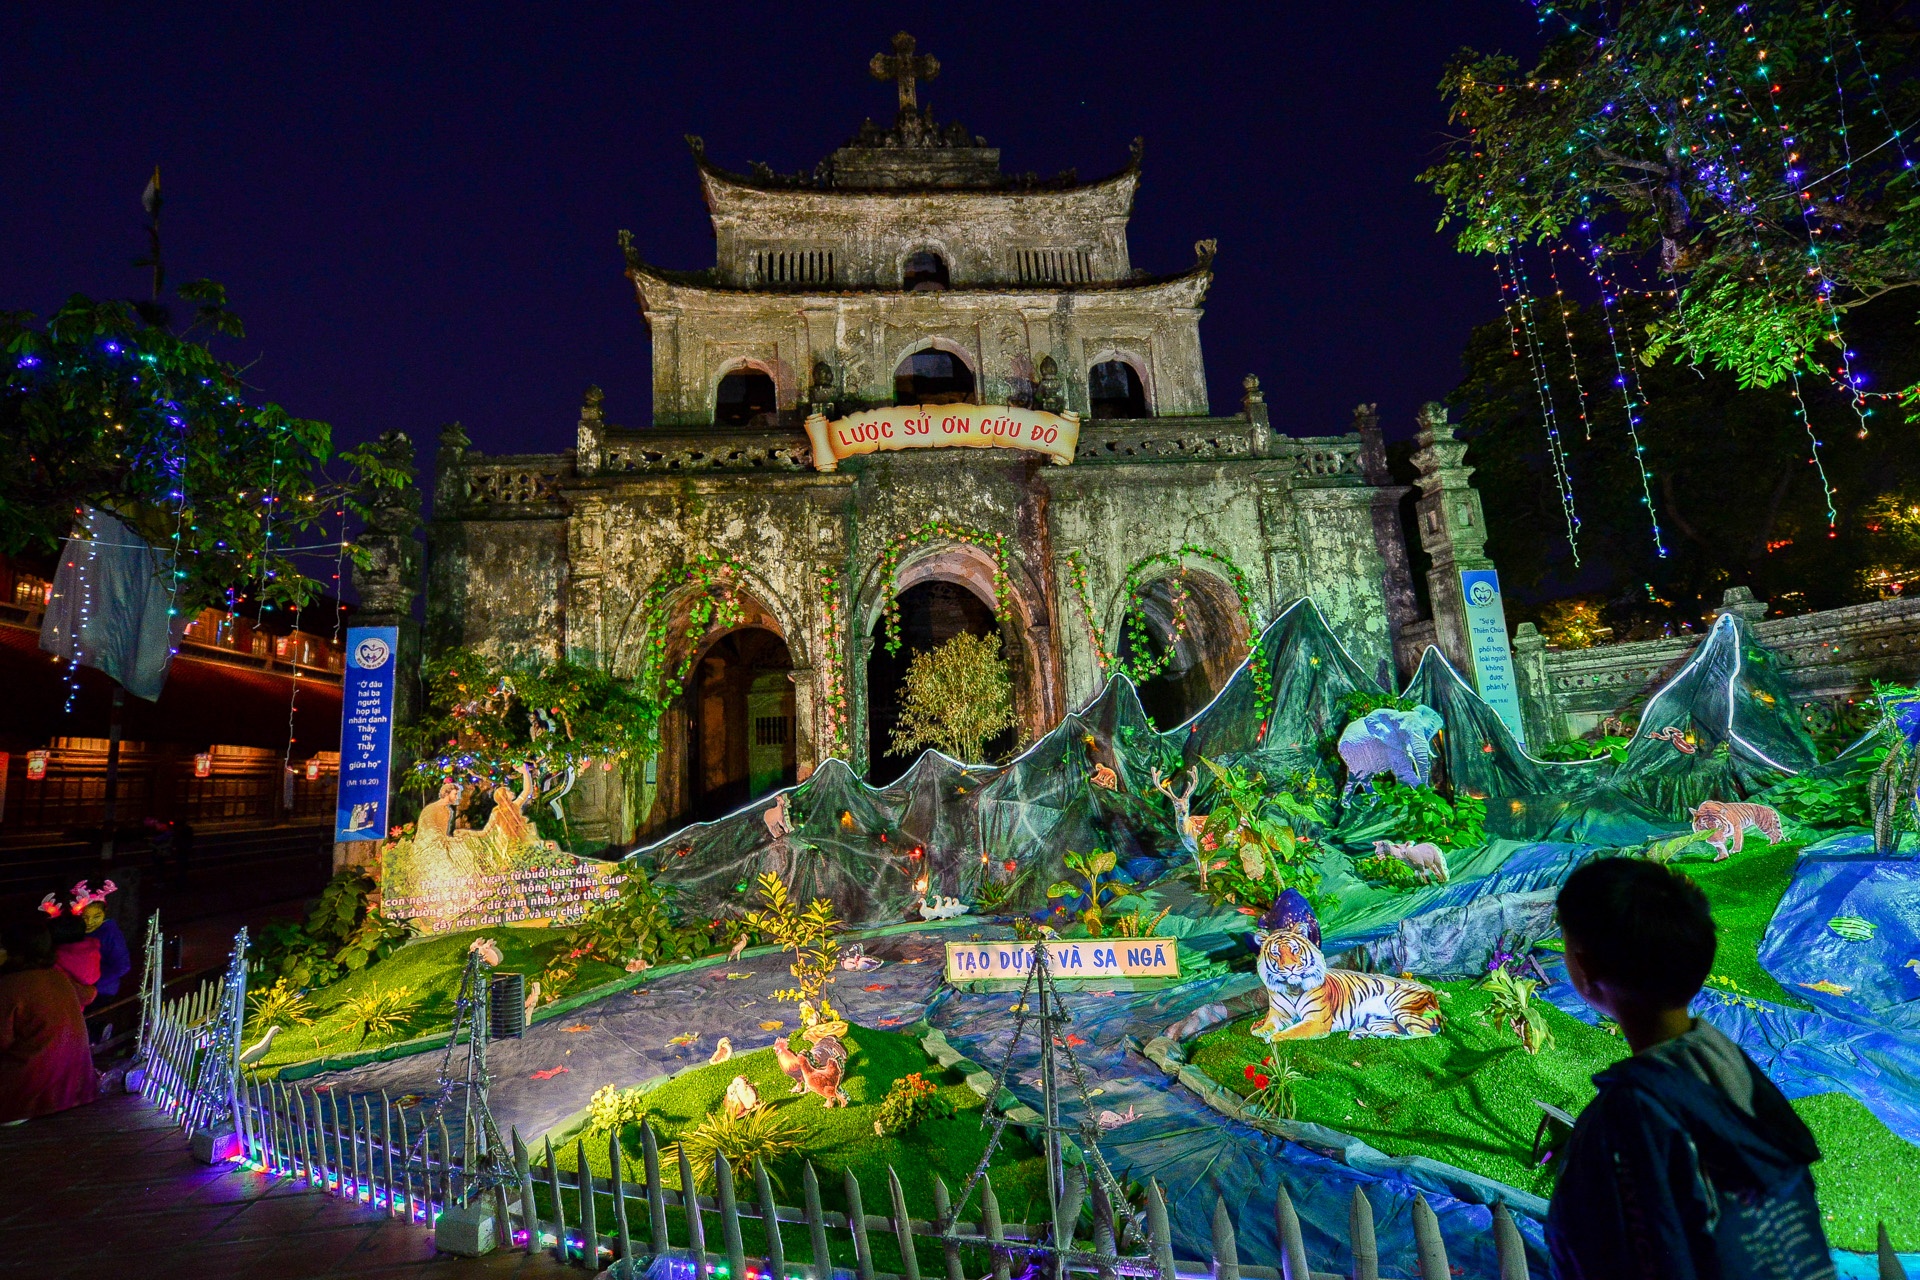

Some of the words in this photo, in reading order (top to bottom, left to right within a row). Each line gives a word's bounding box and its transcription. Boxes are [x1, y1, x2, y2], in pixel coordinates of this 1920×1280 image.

[838, 420, 894, 446] LƯỢC
[903, 410, 931, 436] SỬ
[941, 415, 971, 434] ƠN
[980, 415, 1022, 438] CỨU
[1030, 423, 1060, 448] ĐỘ
[357, 698, 380, 707] người
[348, 716, 367, 724] nhân
[368, 715, 388, 723] danh
[349, 761, 366, 771] giữa
[481, 873, 507, 885] ngay
[524, 865, 549, 880] buổi
[552, 866, 572, 877] ban
[576, 862, 599, 875] đầu,
[384, 898, 405, 907] con
[496, 885, 511, 898] tội
[515, 880, 548, 894] chống
[551, 880, 565, 891] lại
[568, 876, 598, 889] Thiên
[447, 904, 467, 915] cho
[470, 902, 484, 914] sự
[487, 899, 502, 910] dữ
[504, 898, 527, 908] xâm
[530, 894, 558, 907] nhập
[560, 892, 580, 902] vào
[583, 887, 601, 900] thế
[603, 889, 620, 900] gia
[432, 919, 453, 932] gây
[456, 917, 477, 928] nên
[505, 907, 526, 922] khổ
[528, 909, 541, 919] và
[544, 908, 558, 919] sự
[560, 903, 588, 916] chết.
[955, 951, 990, 974] TẠO
[1057, 944, 1083, 969] VÀ
[1092, 948, 1118, 968] SA
[1127, 943, 1167, 968] NGÃ
